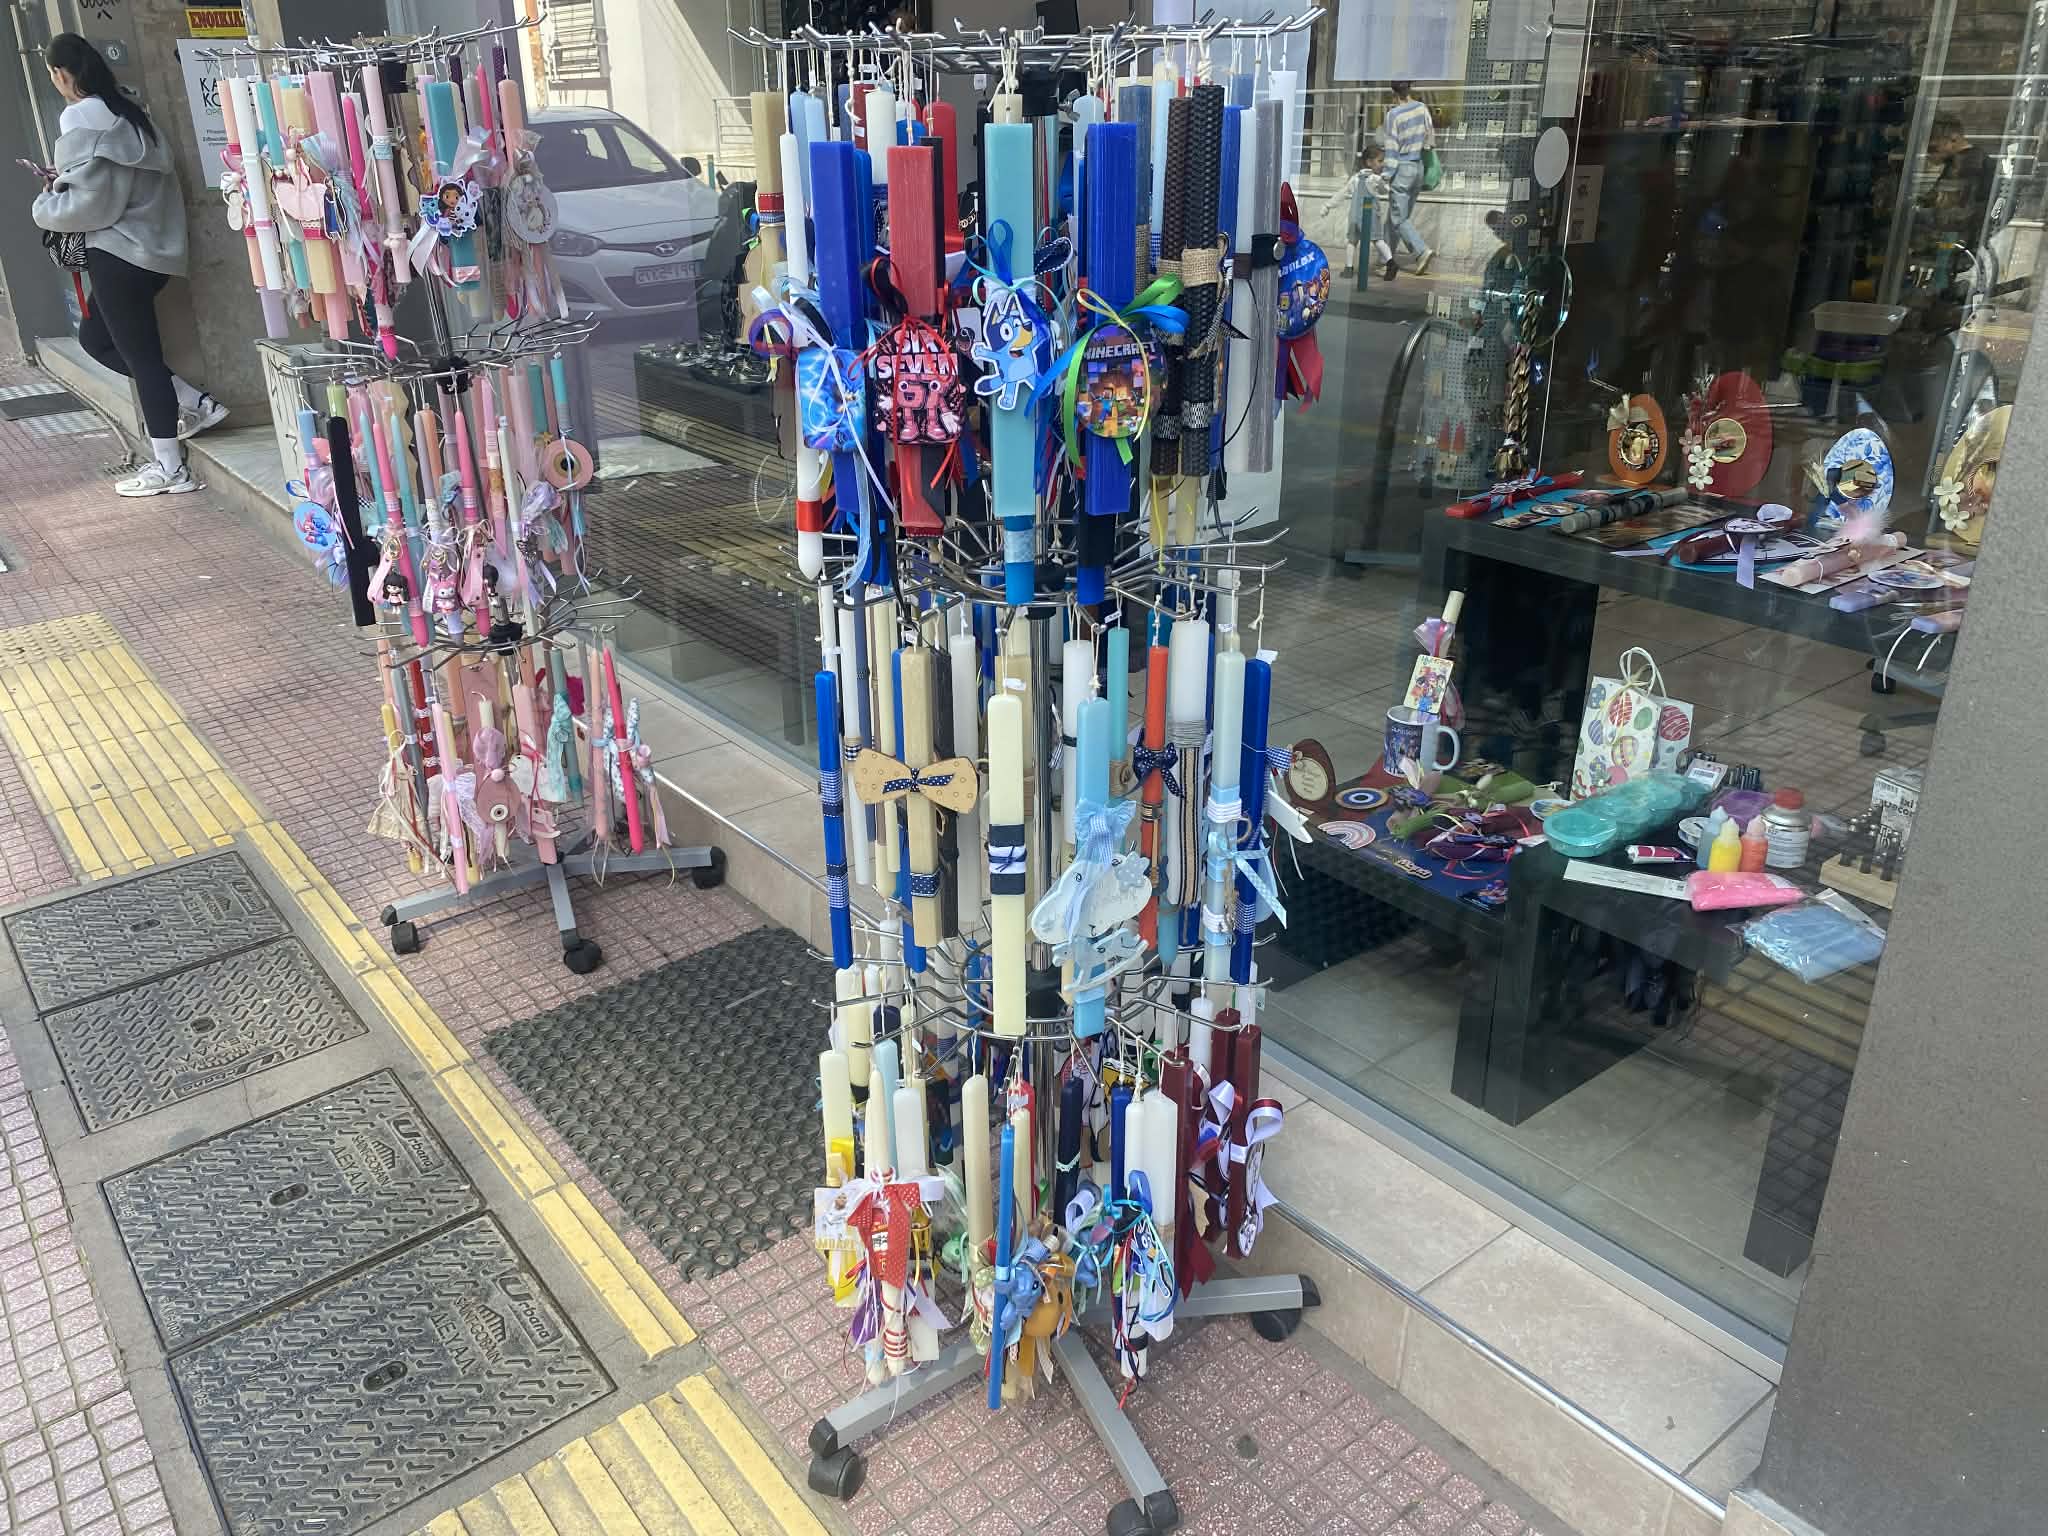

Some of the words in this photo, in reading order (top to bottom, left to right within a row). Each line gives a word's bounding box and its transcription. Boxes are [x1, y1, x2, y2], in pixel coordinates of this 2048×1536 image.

[876, 352, 958, 379] SEVEN
[392, 1119, 434, 1167] Urbana
[499, 1277, 550, 1338] Urbana
